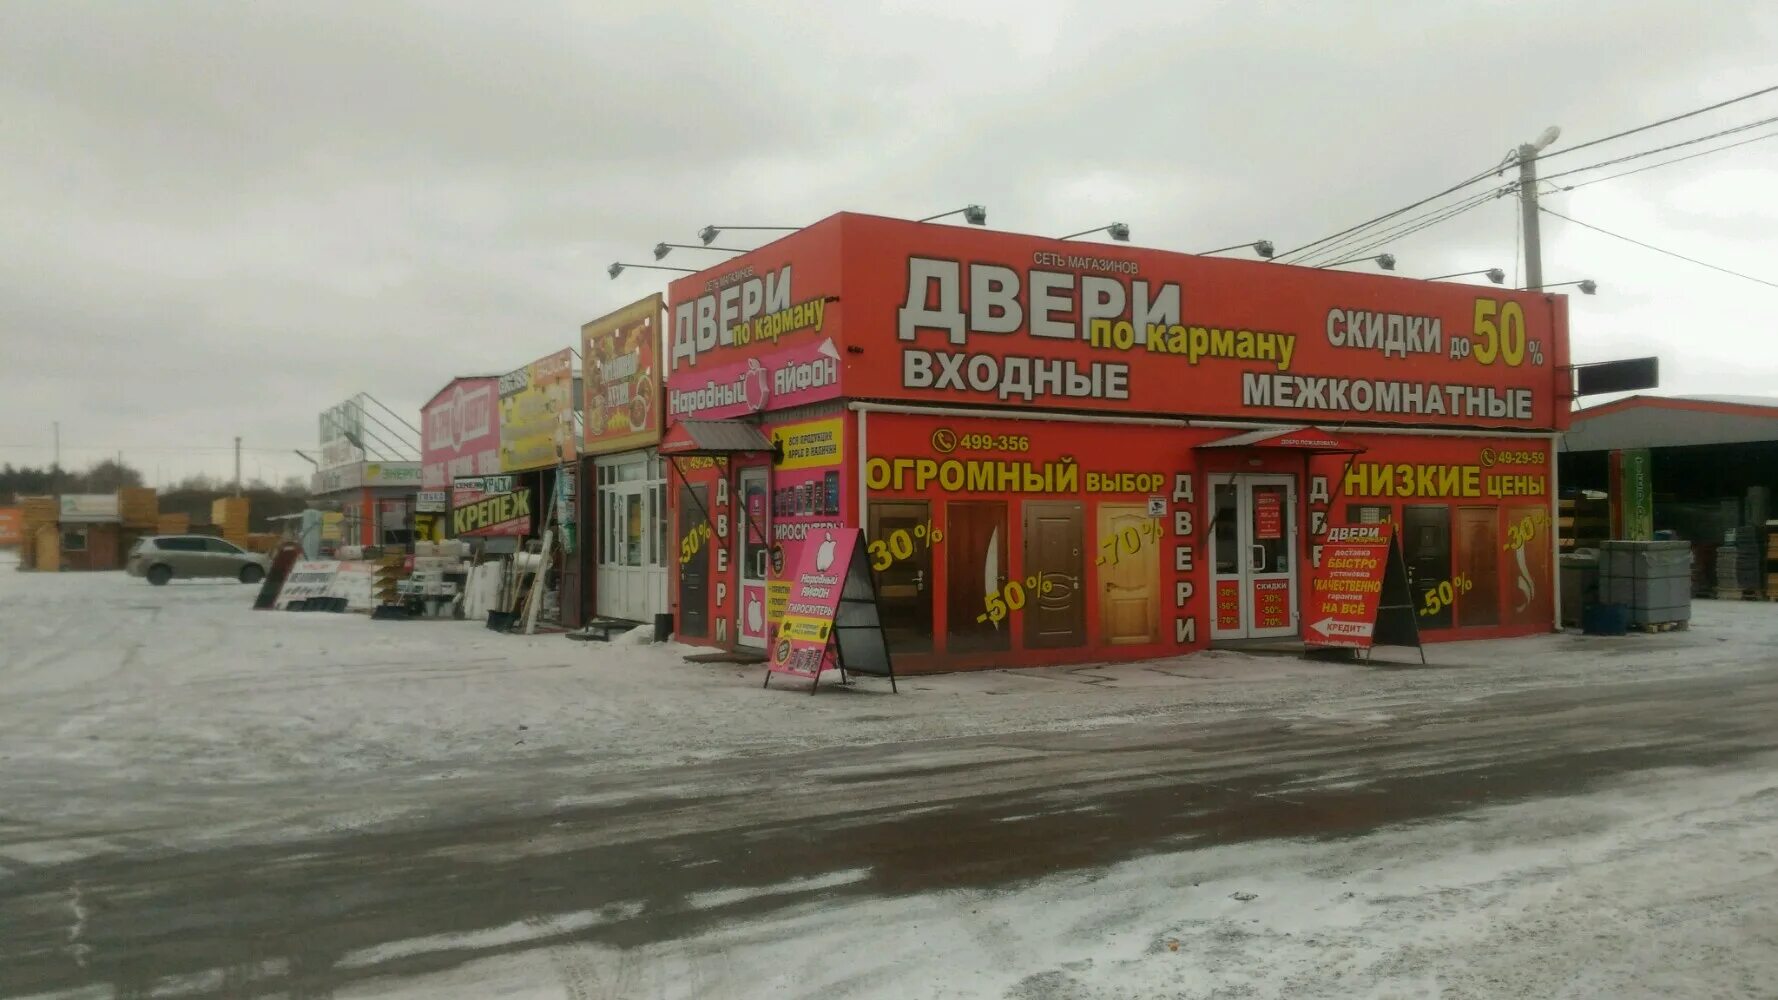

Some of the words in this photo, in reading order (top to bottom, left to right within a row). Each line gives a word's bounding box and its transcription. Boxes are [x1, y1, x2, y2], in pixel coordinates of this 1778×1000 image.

[1033, 251, 1066, 267] СЕТЬ
[1068, 255, 1139, 275] МАГАЗИНОВ
[672, 265, 792, 370] ДВЕРИ
[733, 321, 751, 347] по
[755, 298, 826, 344] карману
[899, 257, 1181, 345] ДВЕРИ
[1091, 319, 1135, 350] по
[1147, 322, 1296, 371] карману
[1326, 308, 1442, 357] СКИДКИ
[903, 350, 1129, 400] ВХОДНЫЕ
[1243, 373, 1533, 419] МЕЖКОМНАТНЫЕ
[959, 434, 1030, 452] 499-356
[1497, 451, 1545, 465] 49-29-59
[866, 457, 1078, 493] ОГРОМНЫЙ
[1085, 472, 1164, 493] ВЫБОР
[1344, 463, 1481, 498] НИЗКИЕ
[1487, 475, 1545, 498] ЦЕНЫ
[453, 488, 531, 536] КРЕПЕЖ
[1327, 527, 1380, 543] ДВЕРИ
[716, 478, 729, 641] ДВЕРИ
[1173, 475, 1196, 643] ДВЕРИ
[1327, 558, 1377, 570] БЫСТРО
[976, 571, 1053, 624] -50%
[1256, 582, 1288, 591] СКИДКИ
[1321, 602, 1338, 613] НА
[1420, 571, 1473, 617] -50%
[787, 603, 834, 617] ГИРОСКУТЕРЫ
